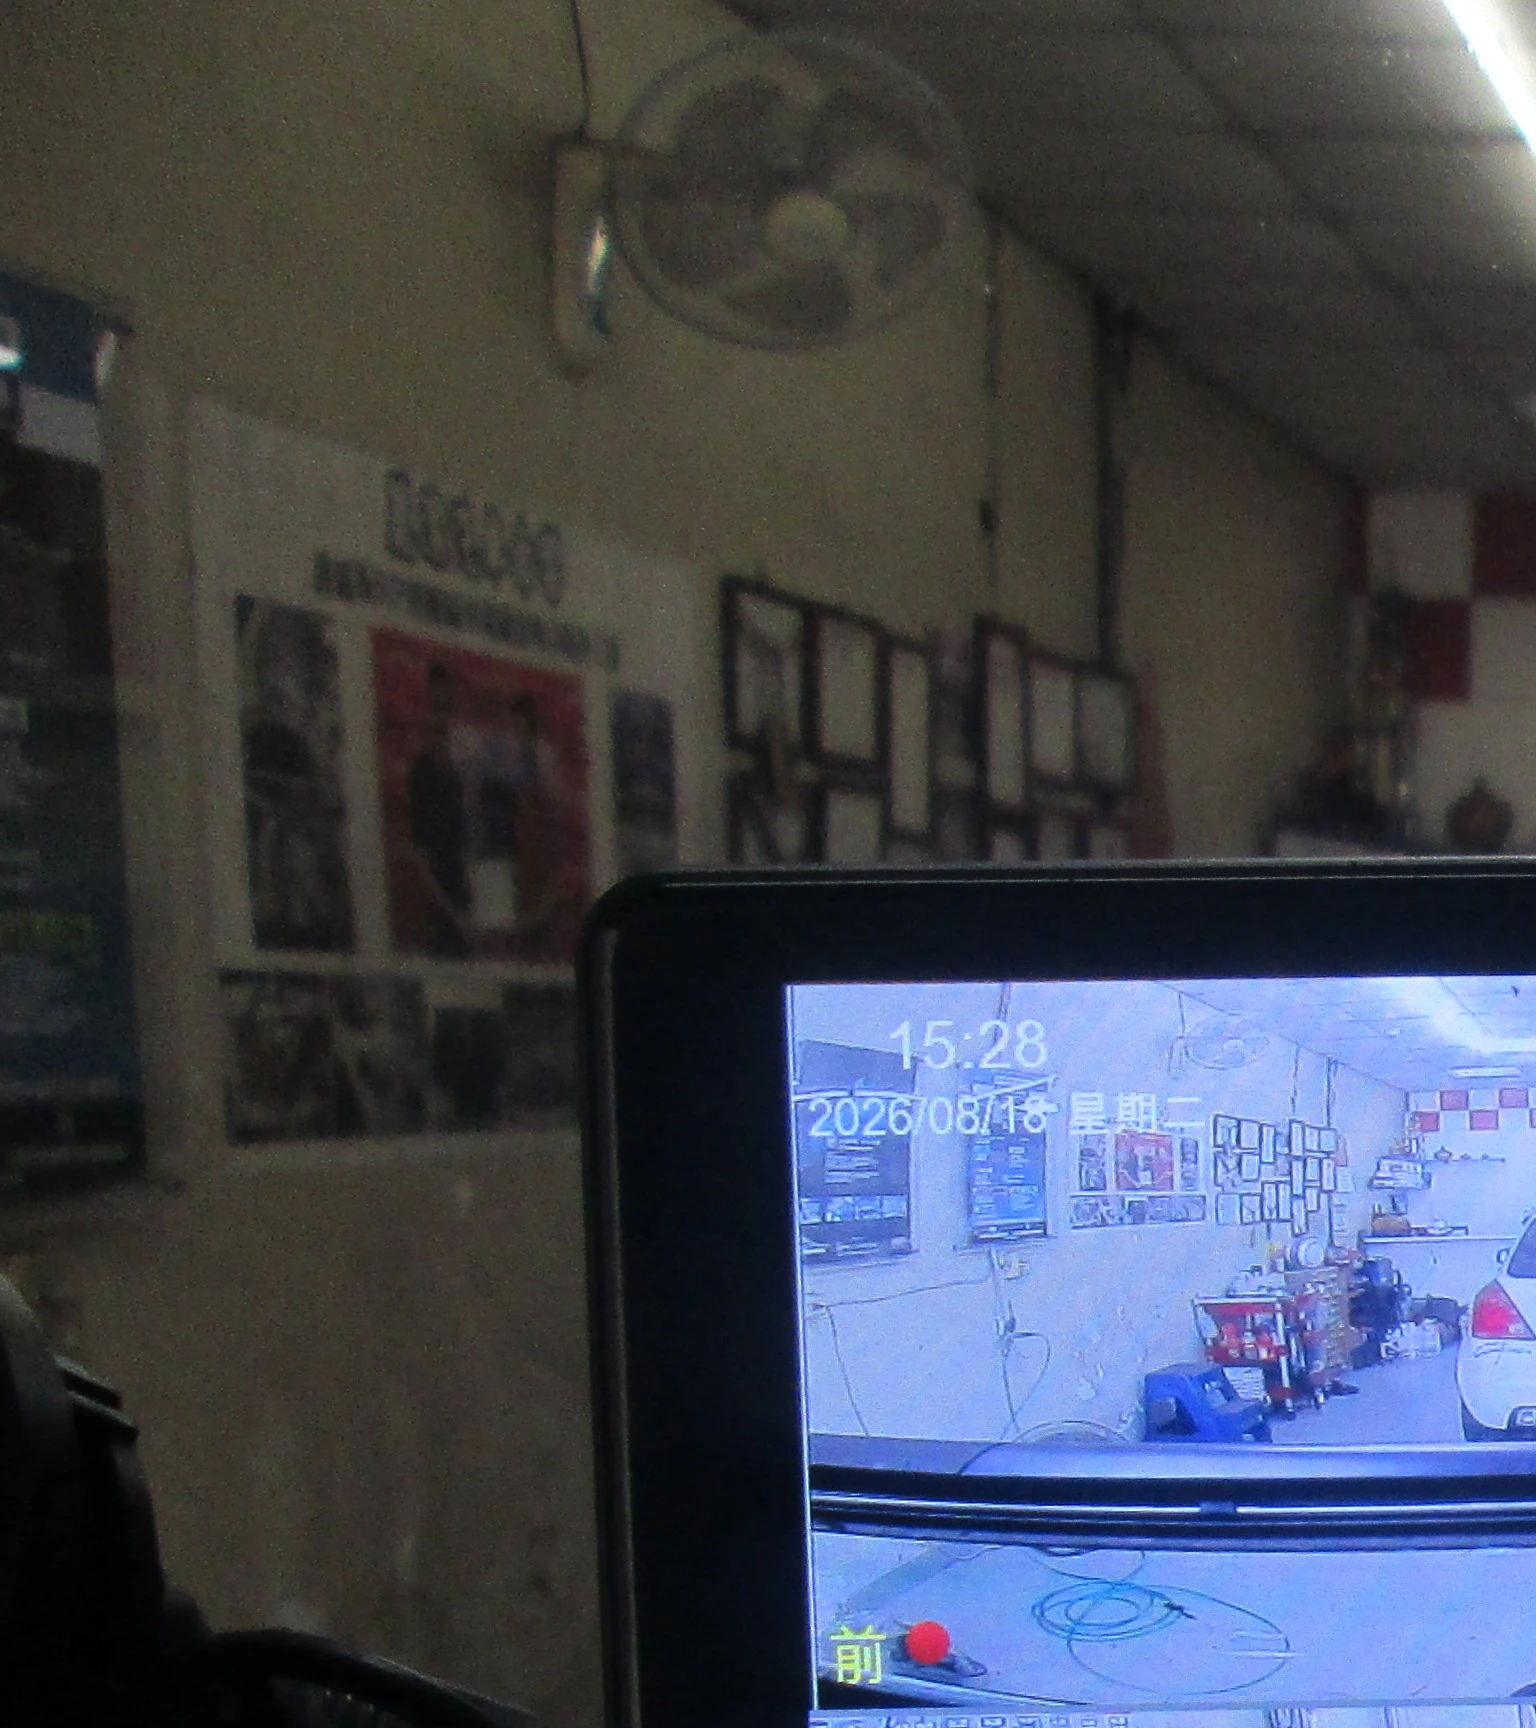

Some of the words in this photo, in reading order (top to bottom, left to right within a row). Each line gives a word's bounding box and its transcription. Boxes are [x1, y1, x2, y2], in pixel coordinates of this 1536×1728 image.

[889, 1019, 1048, 1070] 15:28
[1069, 1092, 1204, 1134] 星期二
[830, 1625, 887, 1684] 前
